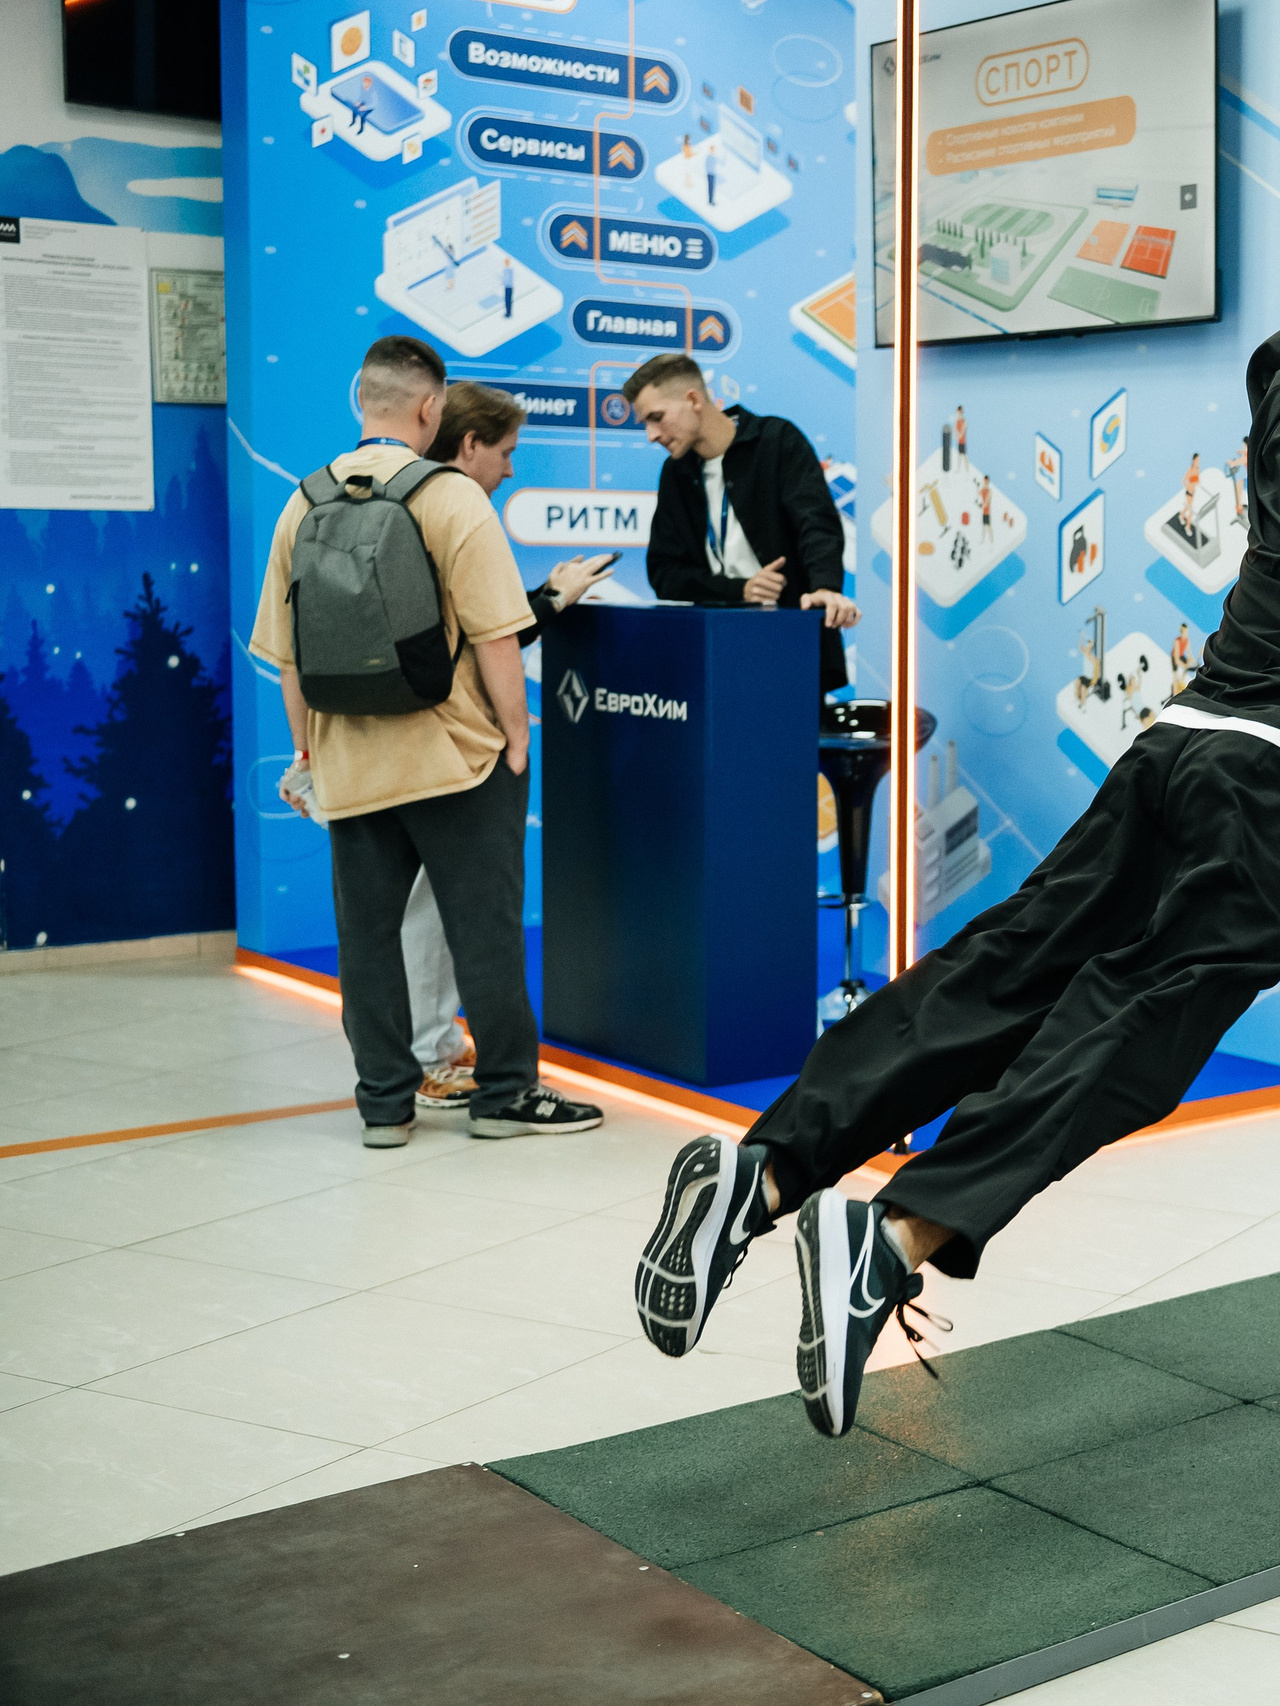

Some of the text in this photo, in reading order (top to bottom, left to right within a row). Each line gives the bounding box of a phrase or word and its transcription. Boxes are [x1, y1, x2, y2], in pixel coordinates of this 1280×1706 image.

[467, 41, 620, 85] Возможности
[985, 51, 1077, 95] СПОРТ
[480, 128, 586, 161] Сервисы
[608, 230, 682, 258] МЕНЮ
[586, 309, 678, 338] Главная
[513, 391, 577, 416] бинет
[546, 505, 638, 530] РИТМ
